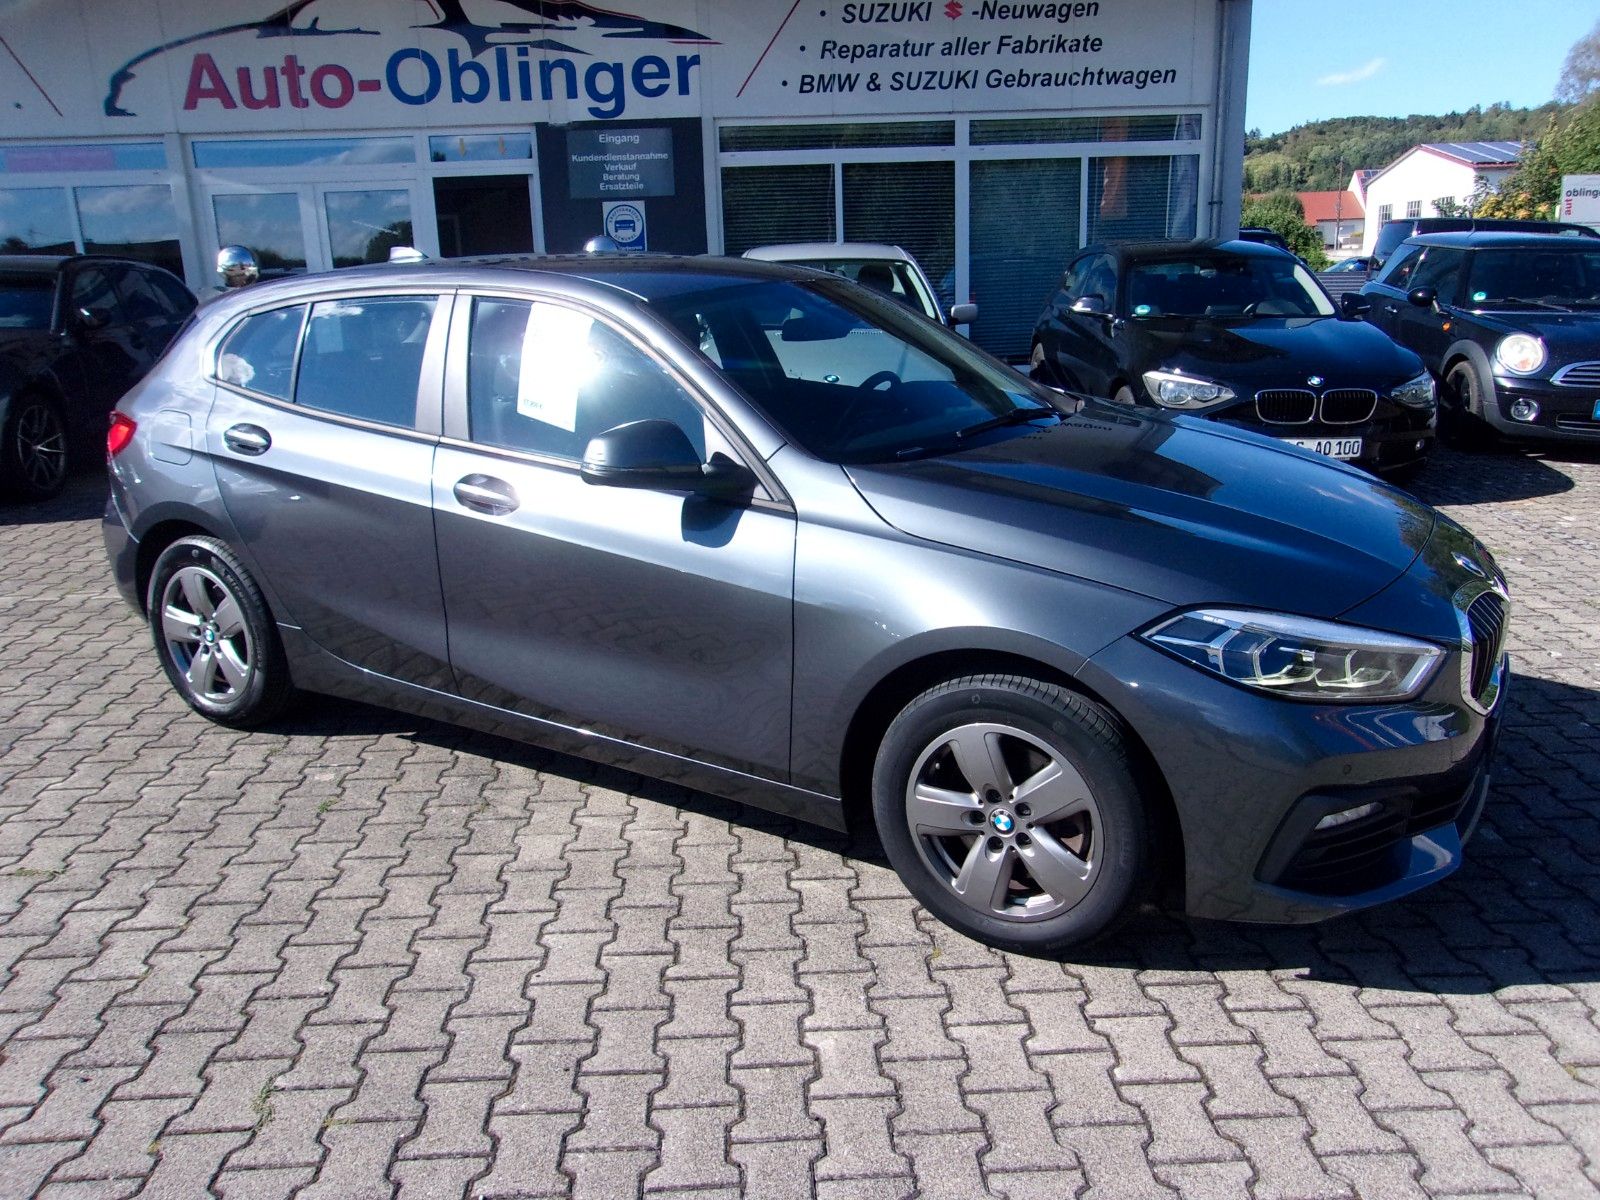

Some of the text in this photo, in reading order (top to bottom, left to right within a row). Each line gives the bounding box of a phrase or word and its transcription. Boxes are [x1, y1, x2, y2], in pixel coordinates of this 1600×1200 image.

[842, 2, 932, 23] SUZUKI
[820, 34, 1103, 63] Reparatur aller Fabrikate
[183, 45, 701, 119] Auto-Oblinger
[799, 67, 1177, 93] BMW & SUZUKI Gebrauchtwagen
[599, 133, 640, 145] Eingang
[571, 152, 669, 162] Kundendienstannahme
[604, 162, 637, 172] Verkauf
[602, 173, 640, 182] Beratung
[599, 182, 644, 191] Ersatzteile
[1566, 188, 1600, 199] obling
[1334, 440, 1360, 456] 100
